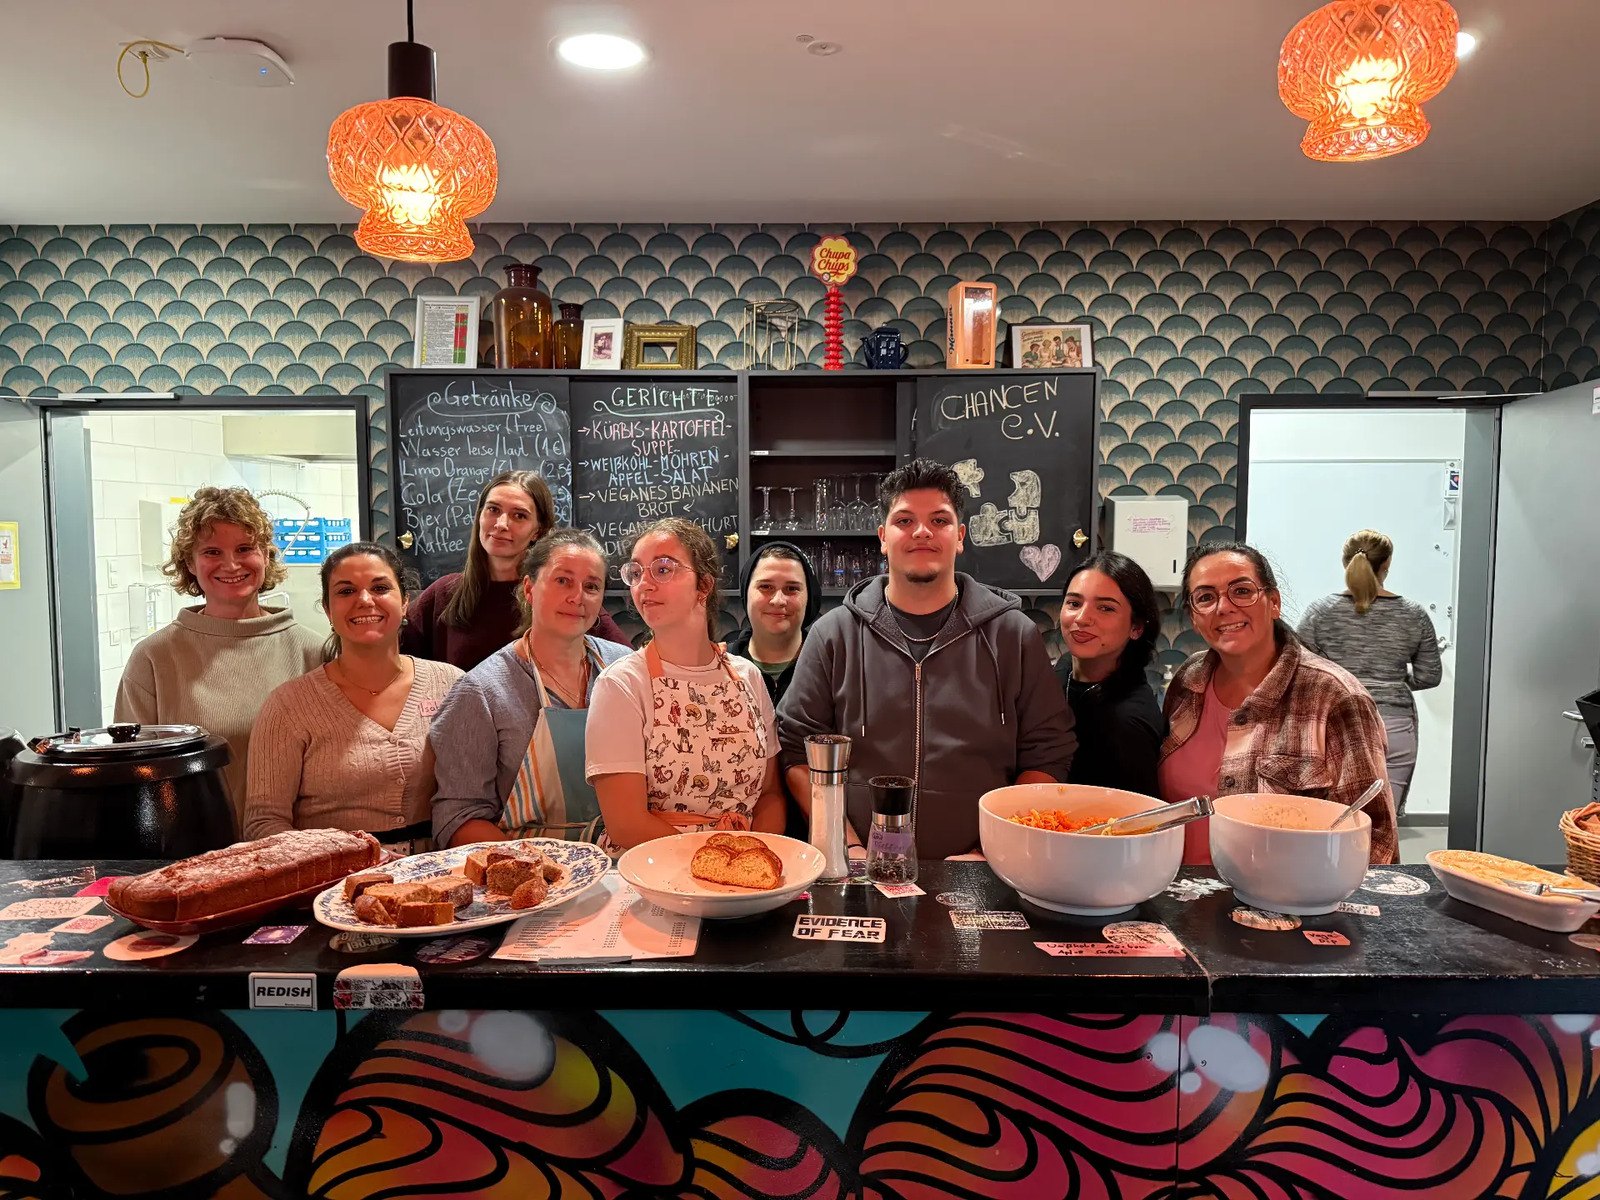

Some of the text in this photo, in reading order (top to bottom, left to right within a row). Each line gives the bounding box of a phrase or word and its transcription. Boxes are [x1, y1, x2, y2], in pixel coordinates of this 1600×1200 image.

[819, 248, 852, 261] Chupa
[817, 259, 850, 272] Chups
[445, 380, 533, 408] Getränke
[940, 377, 1059, 420] CHANCEN
[399, 414, 501, 442] Leitungswasser
[400, 435, 461, 457] Wasser
[632, 438, 676, 457] SUPPE
[402, 460, 441, 478] Limo
[401, 478, 443, 506] Cola
[597, 477, 739, 503] VEGANES BANANEN
[402, 507, 441, 529] Bier
[636, 501, 681, 518] BROT
[413, 526, 466, 556] Kaffee
[798, 916, 883, 929] EVIDENCE
[797, 927, 880, 940] OF FEAR
[256, 986, 311, 997] REDISH
